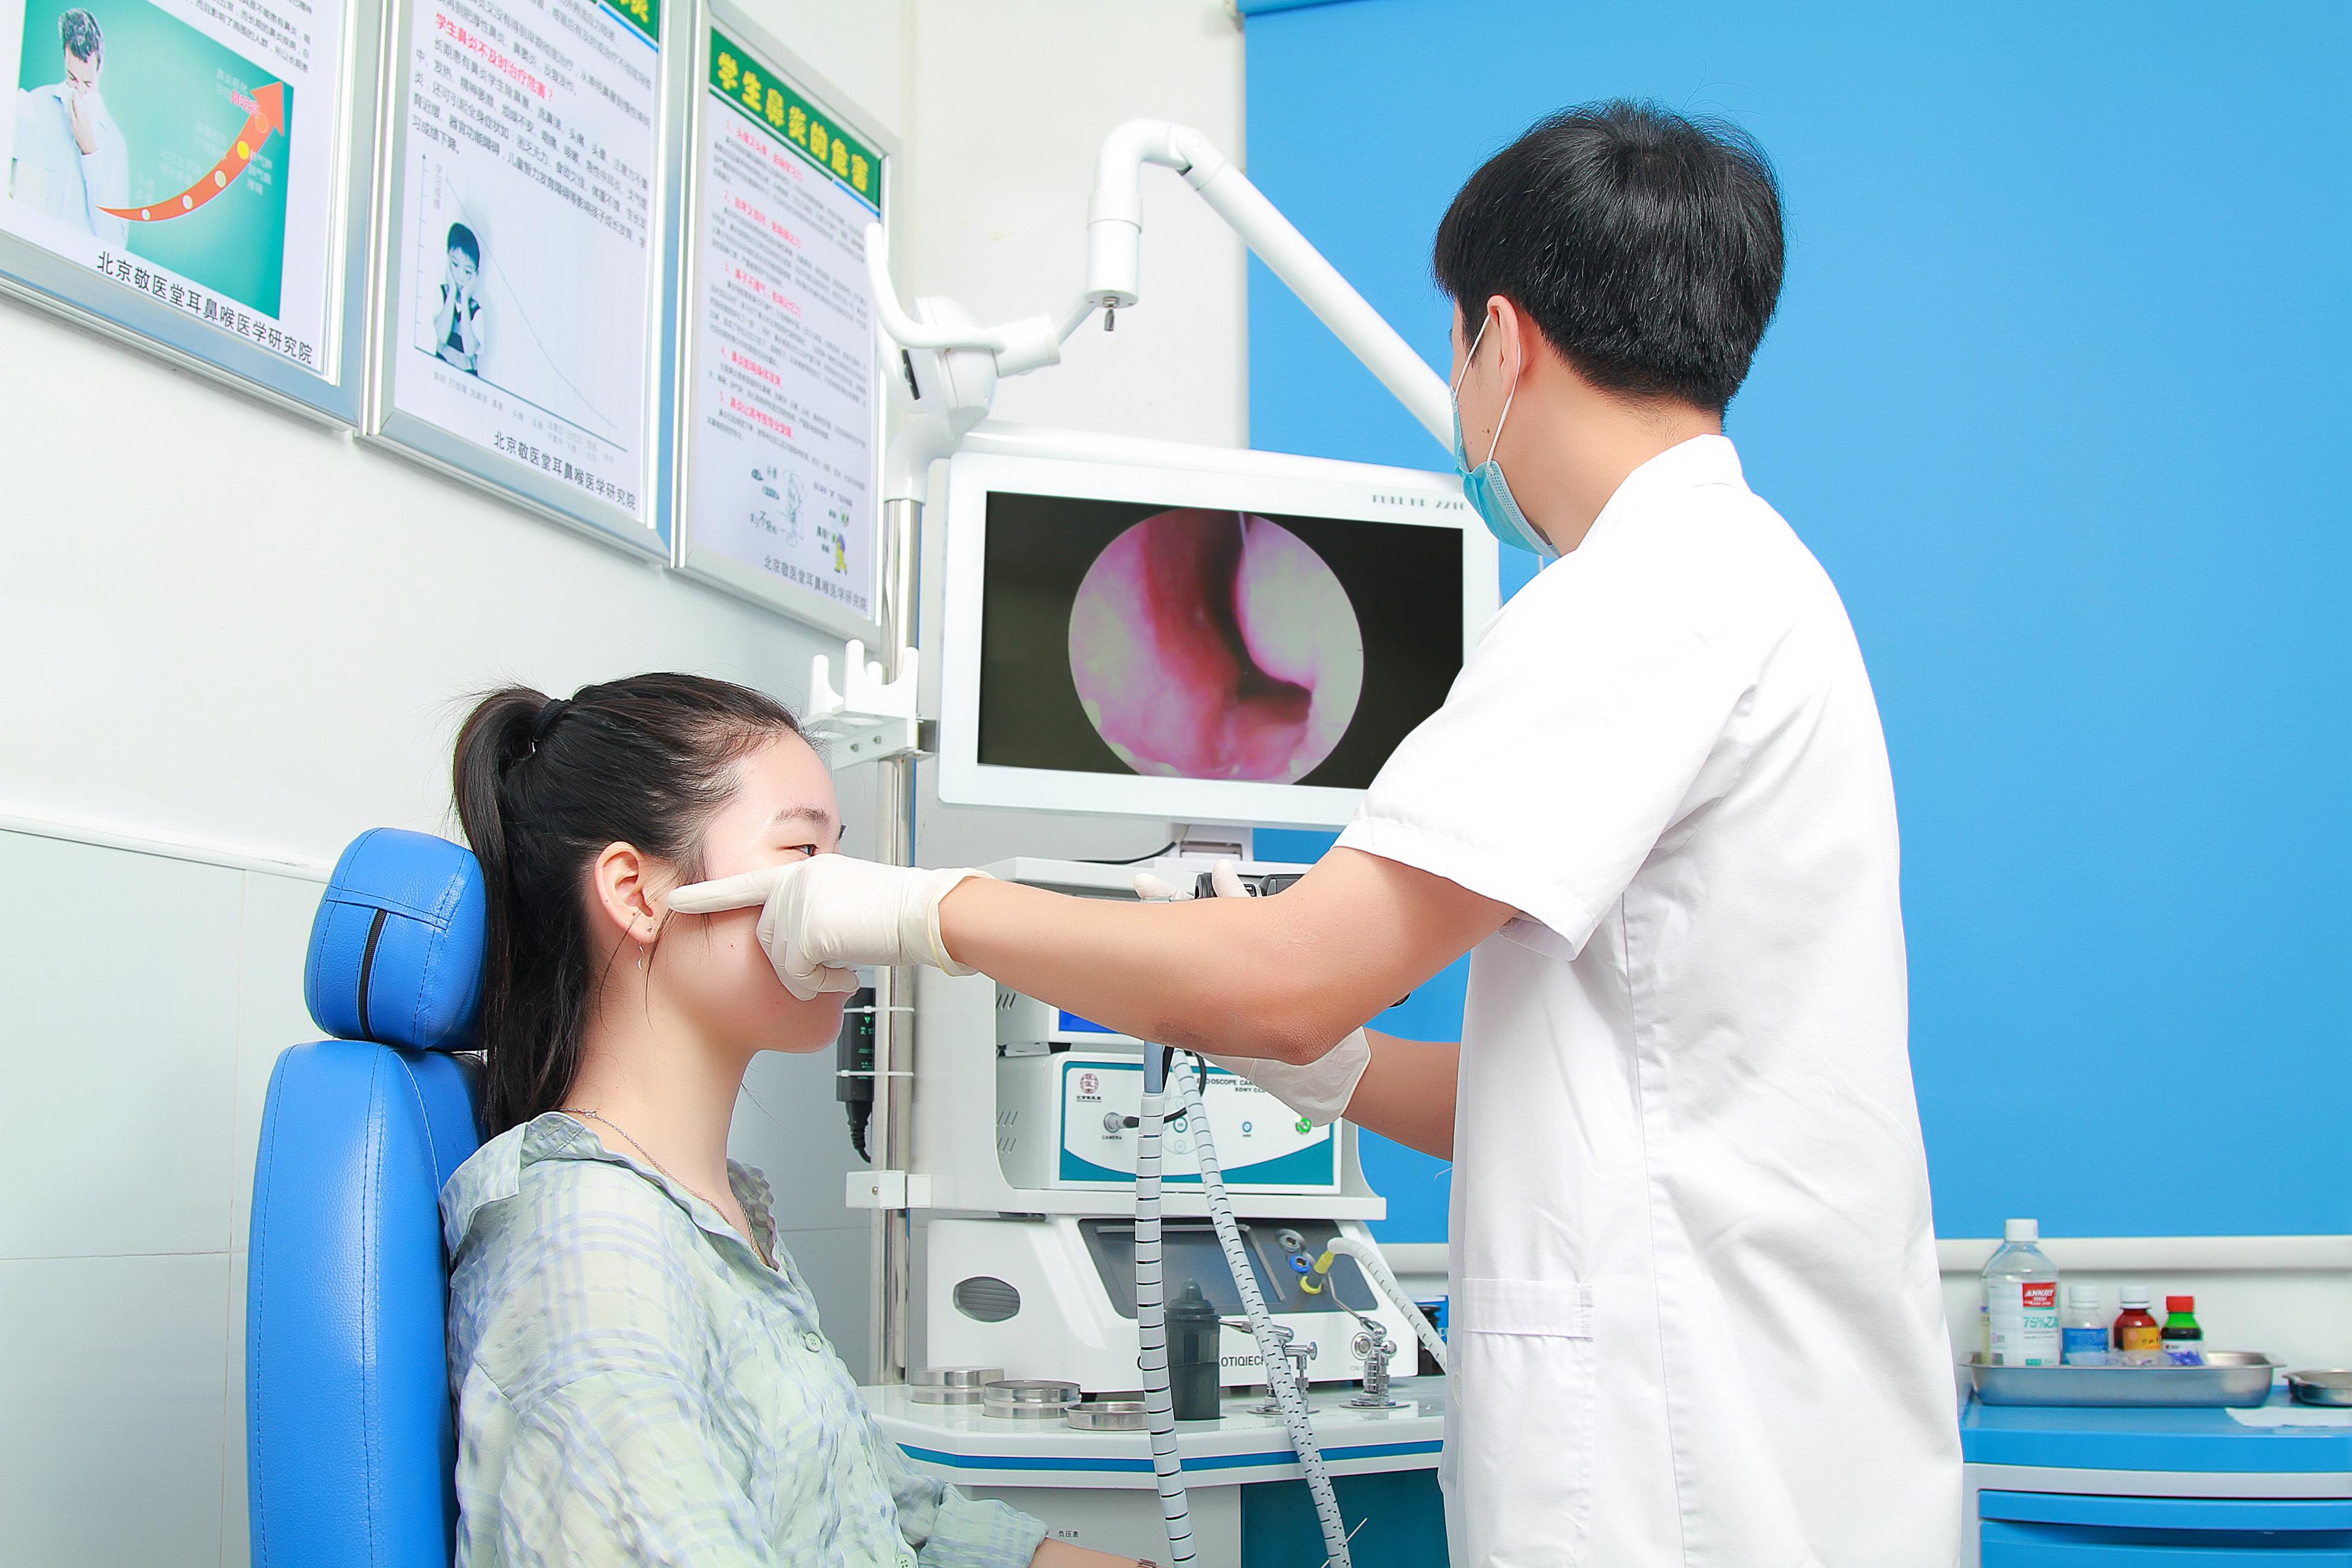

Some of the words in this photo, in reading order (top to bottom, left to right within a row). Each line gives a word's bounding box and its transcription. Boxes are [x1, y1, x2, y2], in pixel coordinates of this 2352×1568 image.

[717, 51, 869, 192] 学生鼻炎的危害
[96, 250, 313, 364] 北京敬医堂耳鼻喉医学研究院
[494, 430, 636, 511] 北京敬医堂耳鼻喉医学研究院
[763, 554, 867, 612] 北京敬医堂耳鼻喉医学研究院
[1221, 1356, 1264, 1367] OTIQIEC
